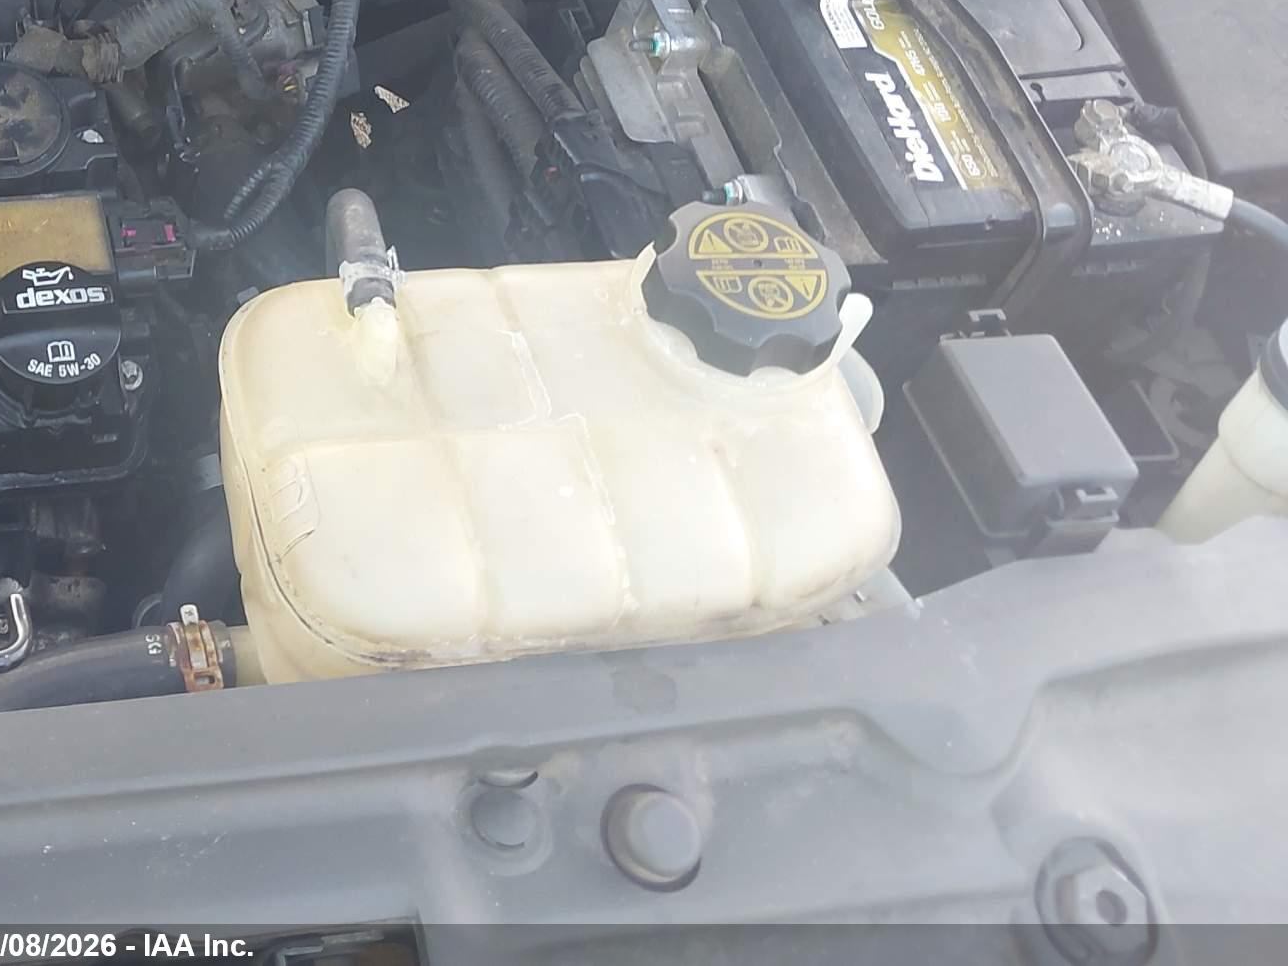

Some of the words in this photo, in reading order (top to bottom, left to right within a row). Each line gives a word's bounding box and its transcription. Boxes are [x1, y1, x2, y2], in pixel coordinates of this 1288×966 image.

[865, 71, 944, 182] DieHard
[16, 287, 105, 309] dexos
[27, 359, 53, 377] SAE
[58, 353, 102, 378] 5W-30
